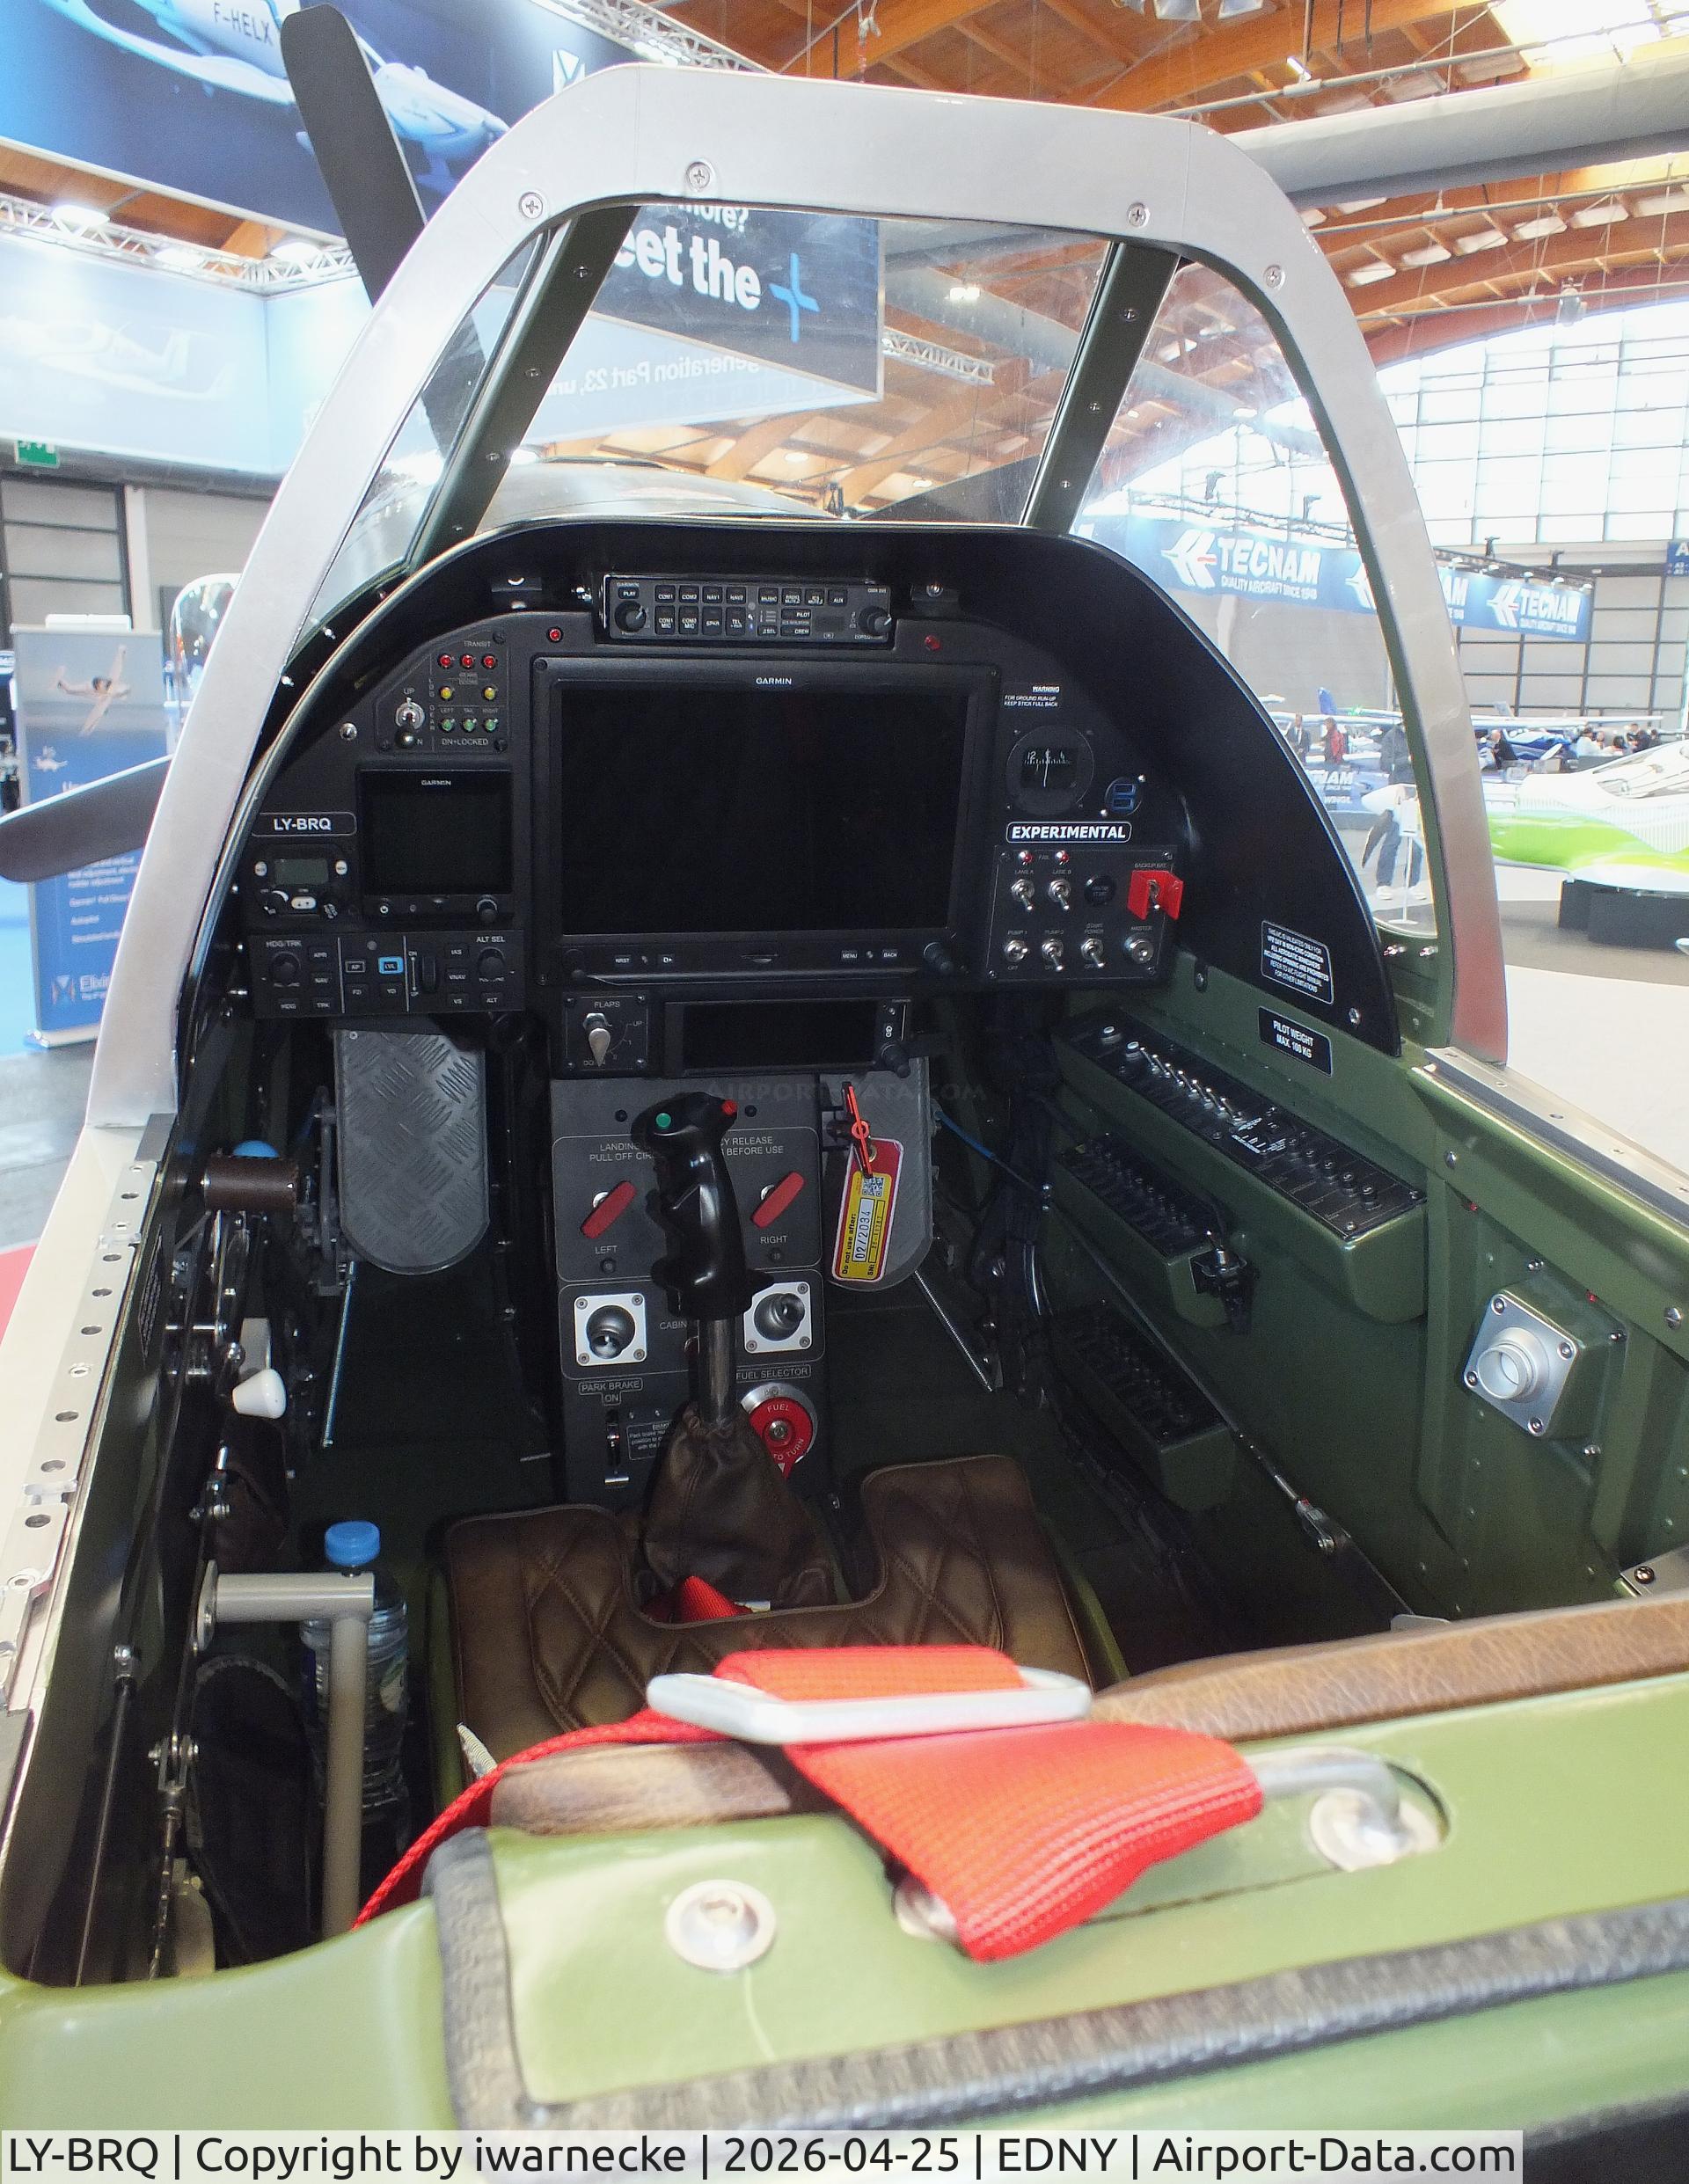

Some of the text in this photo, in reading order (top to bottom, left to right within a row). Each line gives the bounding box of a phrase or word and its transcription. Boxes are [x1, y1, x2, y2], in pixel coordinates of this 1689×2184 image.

[213, 2, 274, 47] F-HELX
[689, 235, 762, 310] the
[1217, 537, 1321, 586] TECNAM
[1519, 587, 1582, 624] TECNAM
[273, 817, 333, 832] LY-BRQ
[1012, 825, 1126, 839] EXPERIMENTAL
[594, 1000, 621, 1009] FLAPS
[1273, 1019, 1313, 1047] PILOT WEIGHT
[1291, 1041, 1302, 1054] 100
[1302, 1046, 1312, 1059] KG
[732, 1136, 773, 1145] RELEASE
[589, 1152, 613, 1162] PULL
[615, 1152, 633, 1161] OFF
[727, 1146, 763, 1156] BEFORE
[765, 1145, 784, 1154] USE
[760, 1235, 787, 1245] RIGHT
[854, 1211, 871, 1260] 02/2034
[595, 1245, 618, 1254] LEFT
[842, 1265, 849, 1275] Do
[659, 1320, 688, 1330] CABIN
[735, 1367, 808, 1380] FUEL SELECTOR
[581, 1380, 640, 1392] PARK BRAKE
[604, 1393, 619, 1403] ON
[766, 1403, 790, 1413] FUEL
[786, 1437, 805, 1457] TURN
